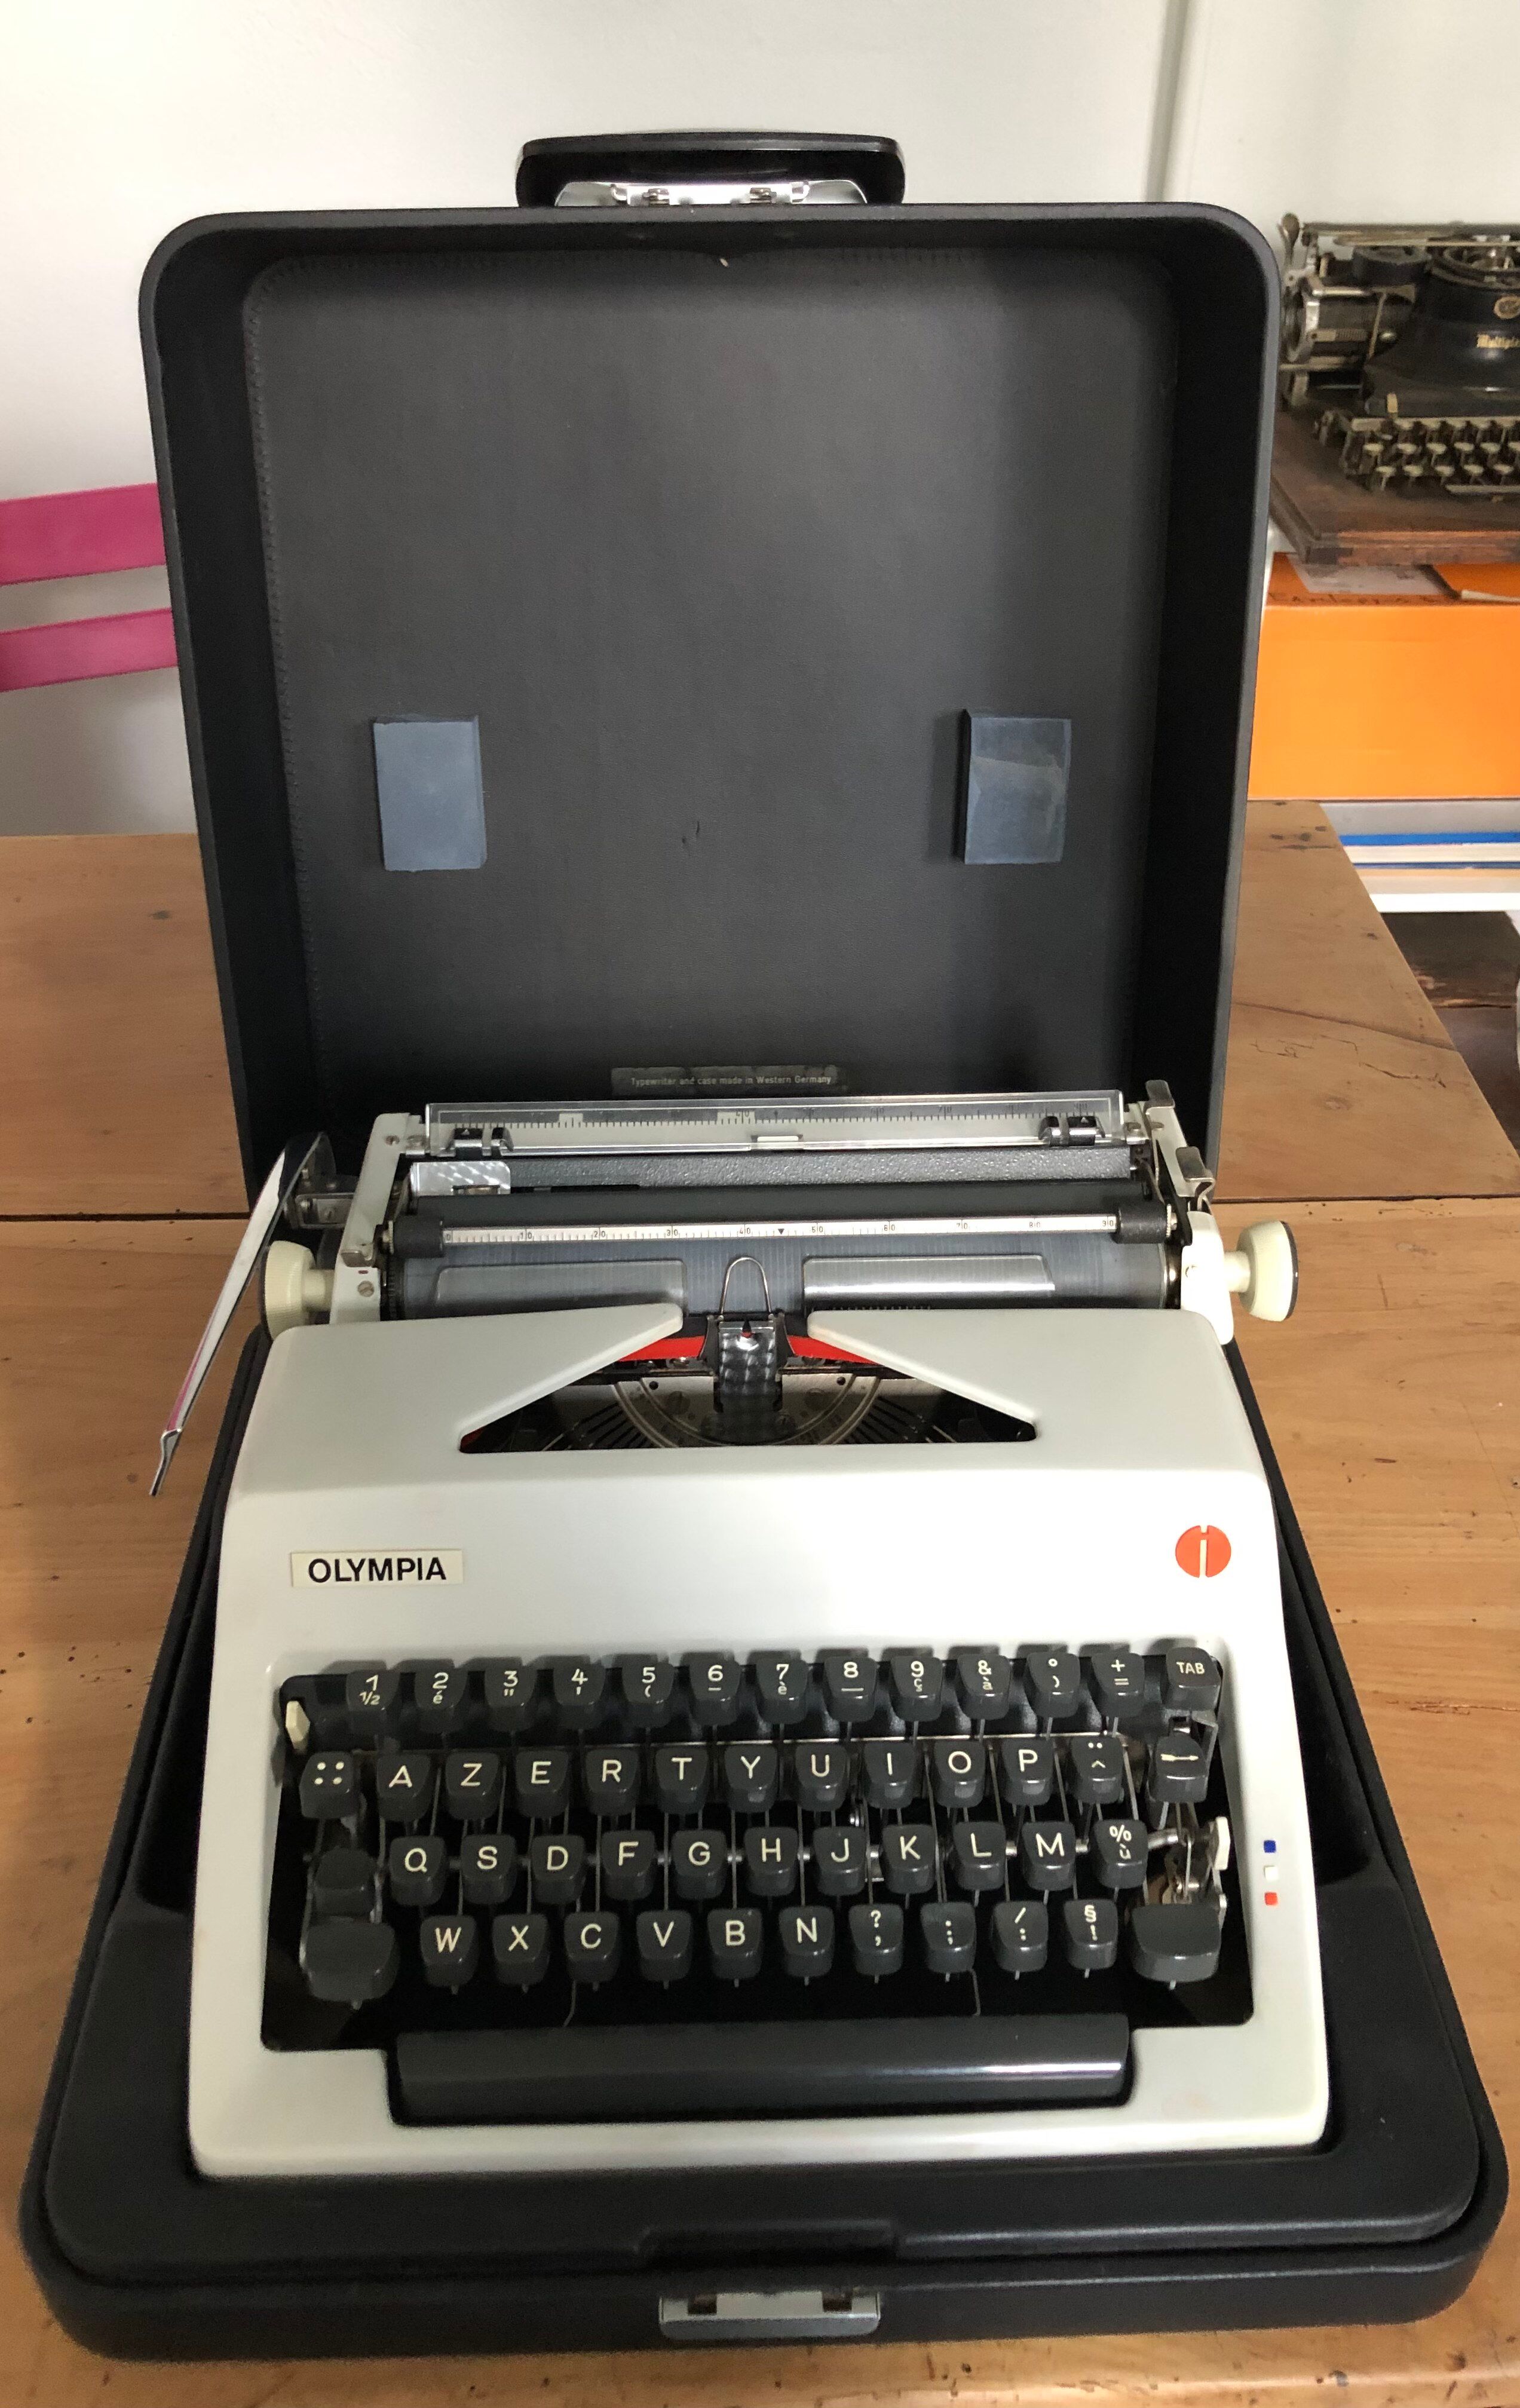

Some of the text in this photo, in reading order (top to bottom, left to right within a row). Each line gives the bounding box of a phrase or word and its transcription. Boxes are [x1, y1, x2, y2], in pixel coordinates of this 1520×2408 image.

[630, 1077, 676, 1088] Typewriter
[679, 1076, 695, 1085] and
[719, 1076, 743, 1085] made
[755, 1075, 792, 1084] Western
[794, 1074, 832, 1086] Germany
[308, 1557, 447, 1583] OLYMPIA
[365, 1674, 379, 1692] 1
[432, 1672, 449, 1690] 2
[503, 1670, 519, 1687] 3
[571, 1668, 589, 1685] 4
[642, 1666, 657, 1684] 5
[708, 1664, 724, 1682] 6
[776, 1663, 789, 1680] 7
[843, 1661, 860, 1678] 8
[911, 1661, 924, 1677] 9
[977, 1659, 992, 1676] &
[1176, 1661, 1206, 1675] TAB
[432, 1690, 443, 1704] é
[982, 1676, 993, 1690] à
[388, 1764, 413, 1788] A
[460, 1762, 483, 1787] Z
[531, 1760, 552, 1784] E
[602, 1759, 622, 1783] R
[671, 1757, 692, 1781] T
[740, 1756, 761, 1779] Y
[811, 1754, 830, 1778] U
[887, 1752, 893, 1776] I
[948, 1751, 972, 1774] O
[1018, 1749, 1038, 1772] P
[404, 1824, 1132, 1873] Q S D F G H J K L M %
[435, 1921, 462, 1953] W
[508, 1920, 529, 1951] X
[580, 1919, 602, 1949] C
[653, 1921, 675, 1948] V
[725, 1919, 746, 1946] B
[796, 1916, 818, 1944] N
[870, 1909, 882, 1928] ?
